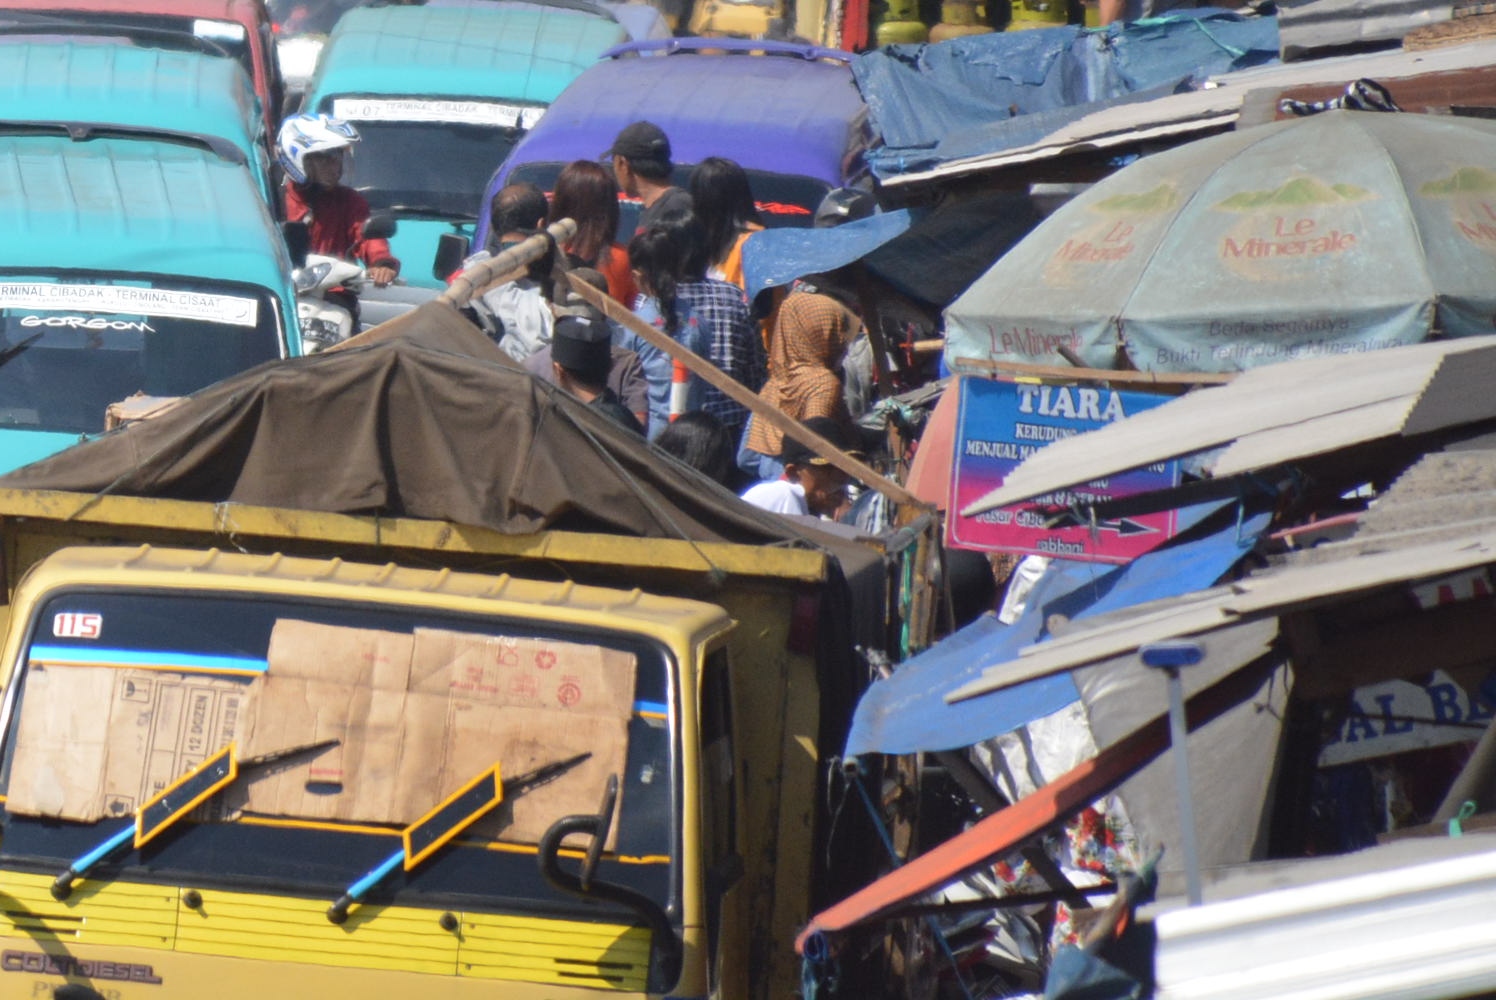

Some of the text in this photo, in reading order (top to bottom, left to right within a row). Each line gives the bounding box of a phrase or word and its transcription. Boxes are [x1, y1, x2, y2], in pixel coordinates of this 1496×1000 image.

[1273, 216, 1316, 238] Le
[1221, 230, 1358, 260] Minerale
[49, 287, 104, 298] CIBADAK
[115, 289, 177, 304] TERMINAL
[1209, 318, 1255, 338] Beda
[1155, 347, 1201, 366] Bukti
[1016, 384, 1130, 420] TIARA
[965, 439, 1019, 460] MENJUAL
[1035, 537, 1085, 554] rabbani
[57, 614, 99, 637] 115
[191, 695, 208, 736] DOZEN
[188, 737, 201, 752] 12
